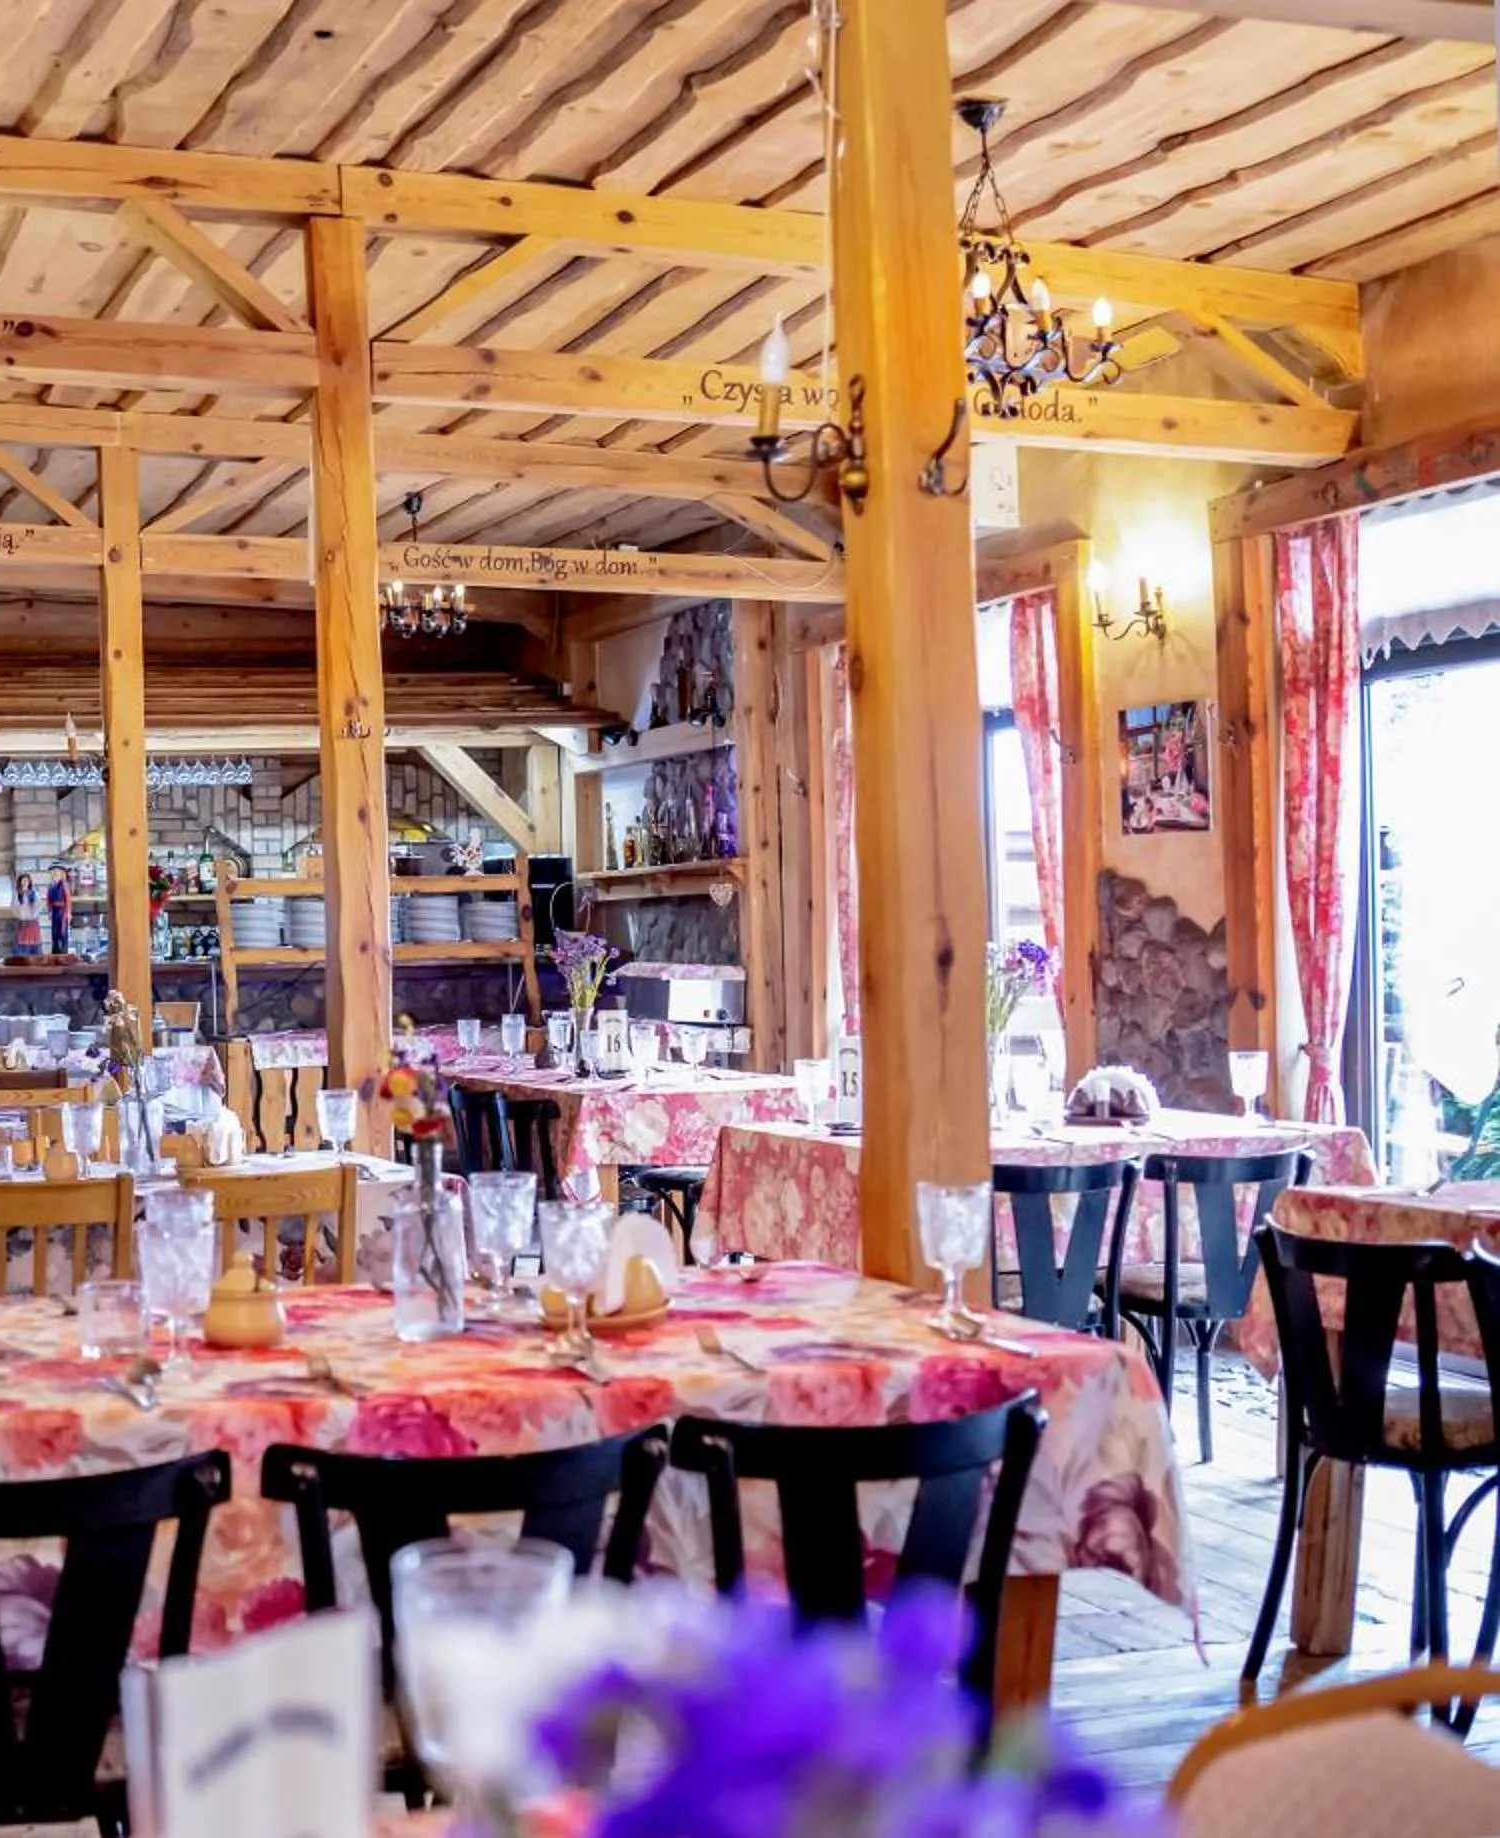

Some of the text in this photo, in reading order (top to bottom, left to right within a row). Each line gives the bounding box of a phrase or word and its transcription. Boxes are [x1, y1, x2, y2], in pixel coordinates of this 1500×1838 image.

[458, 554, 474, 569] w
[573, 559, 589, 574] w
[606, 1032, 621, 1053] 16
[841, 1071, 858, 1098] 15
